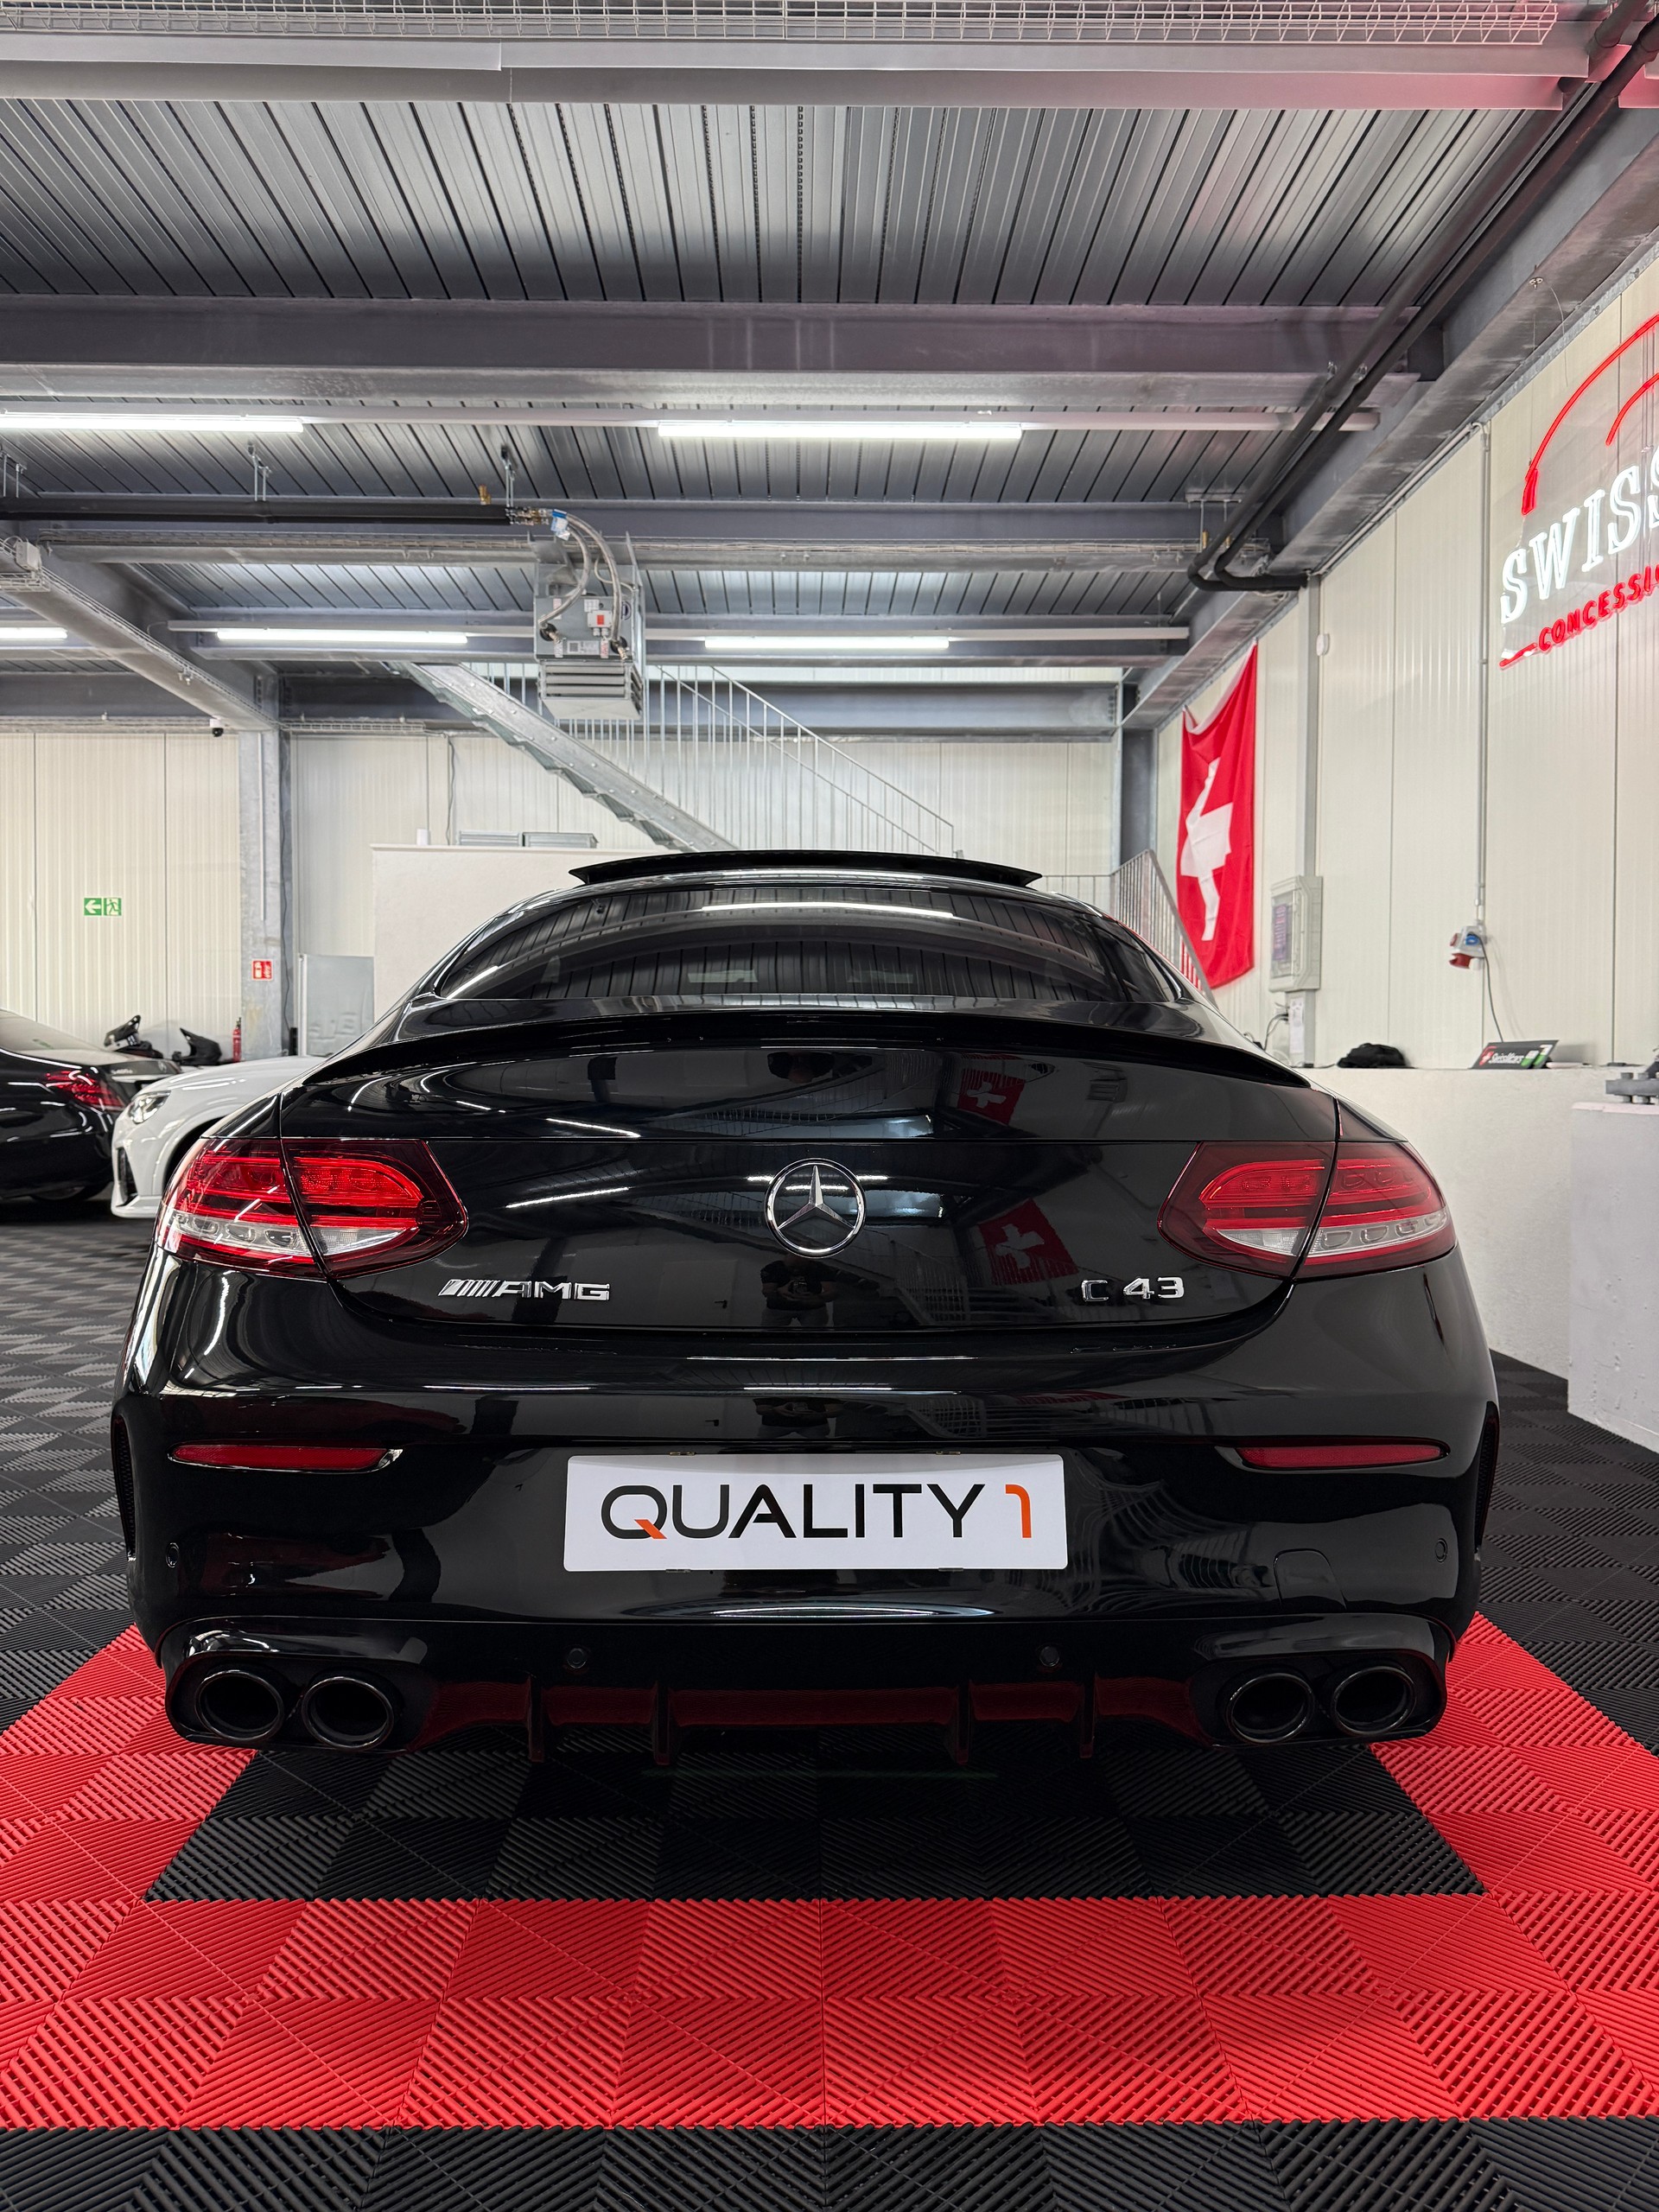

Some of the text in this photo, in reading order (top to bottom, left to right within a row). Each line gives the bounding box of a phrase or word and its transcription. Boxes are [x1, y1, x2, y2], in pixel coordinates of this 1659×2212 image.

[1081, 1276, 1185, 1302] C 43
[601, 1483, 1033, 1541] QUALITY 1
